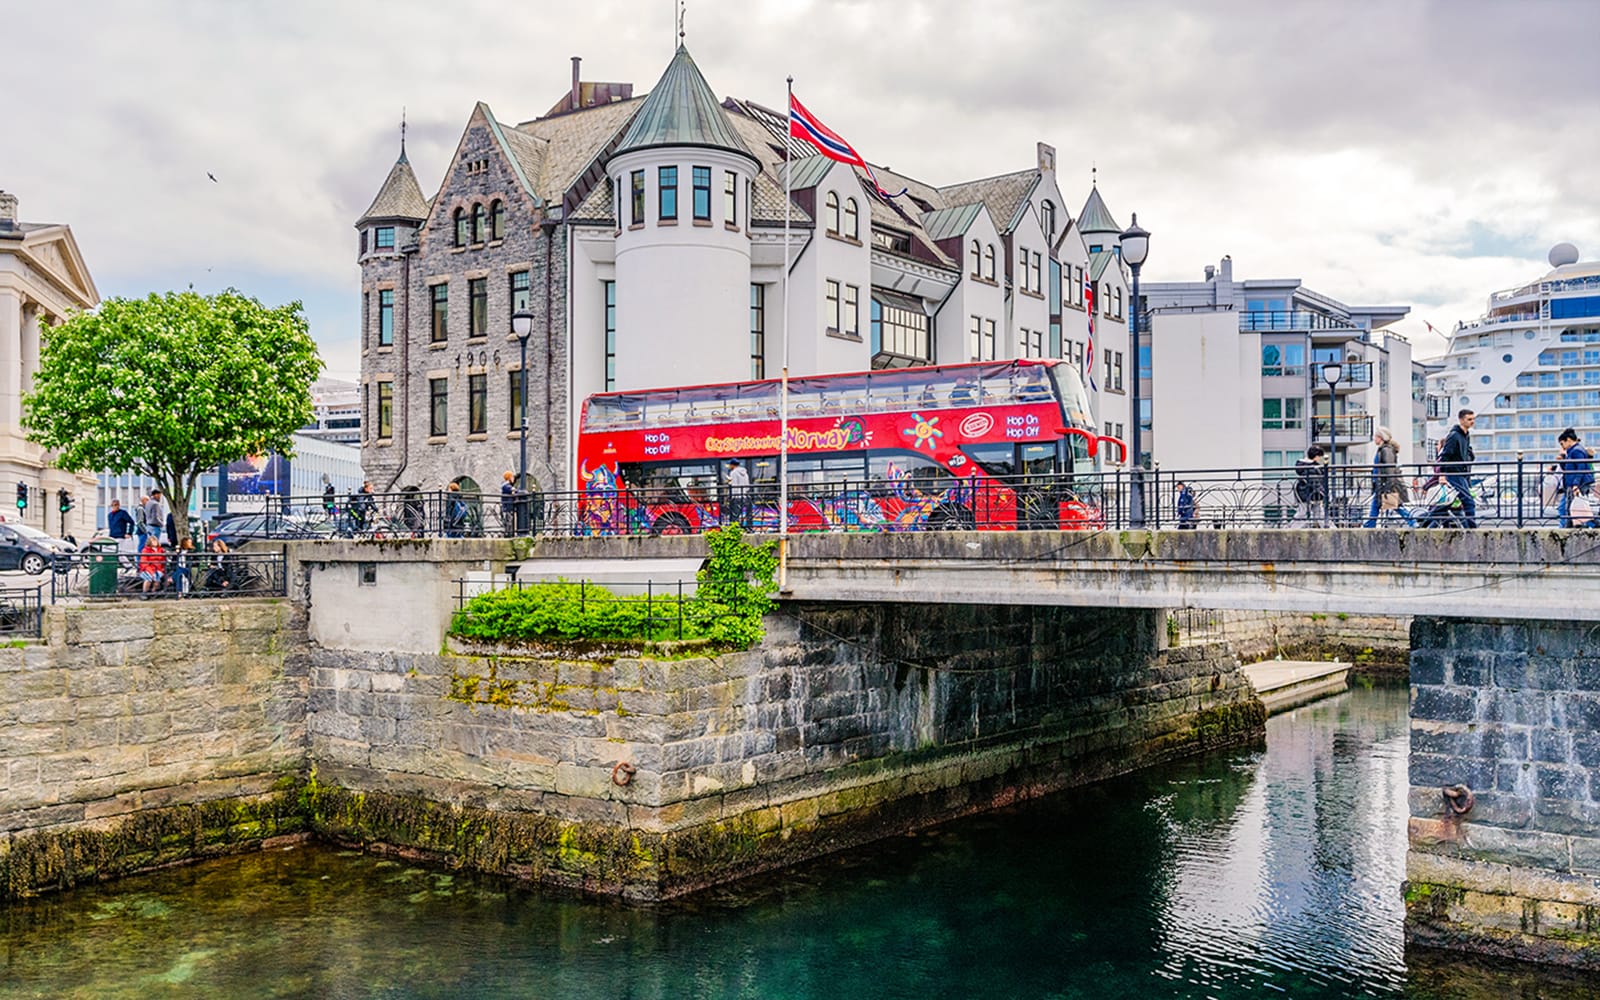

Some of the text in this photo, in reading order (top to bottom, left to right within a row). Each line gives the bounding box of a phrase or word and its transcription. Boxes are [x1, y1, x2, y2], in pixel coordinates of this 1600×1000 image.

[455, 349, 501, 369] 1906
[1006, 414, 1039, 426] Hop On
[644, 433, 670, 443] Hop On
[1006, 426, 1040, 438] Hop Off
[787, 427, 850, 450] Norway
[644, 444, 671, 455] Hop Off
